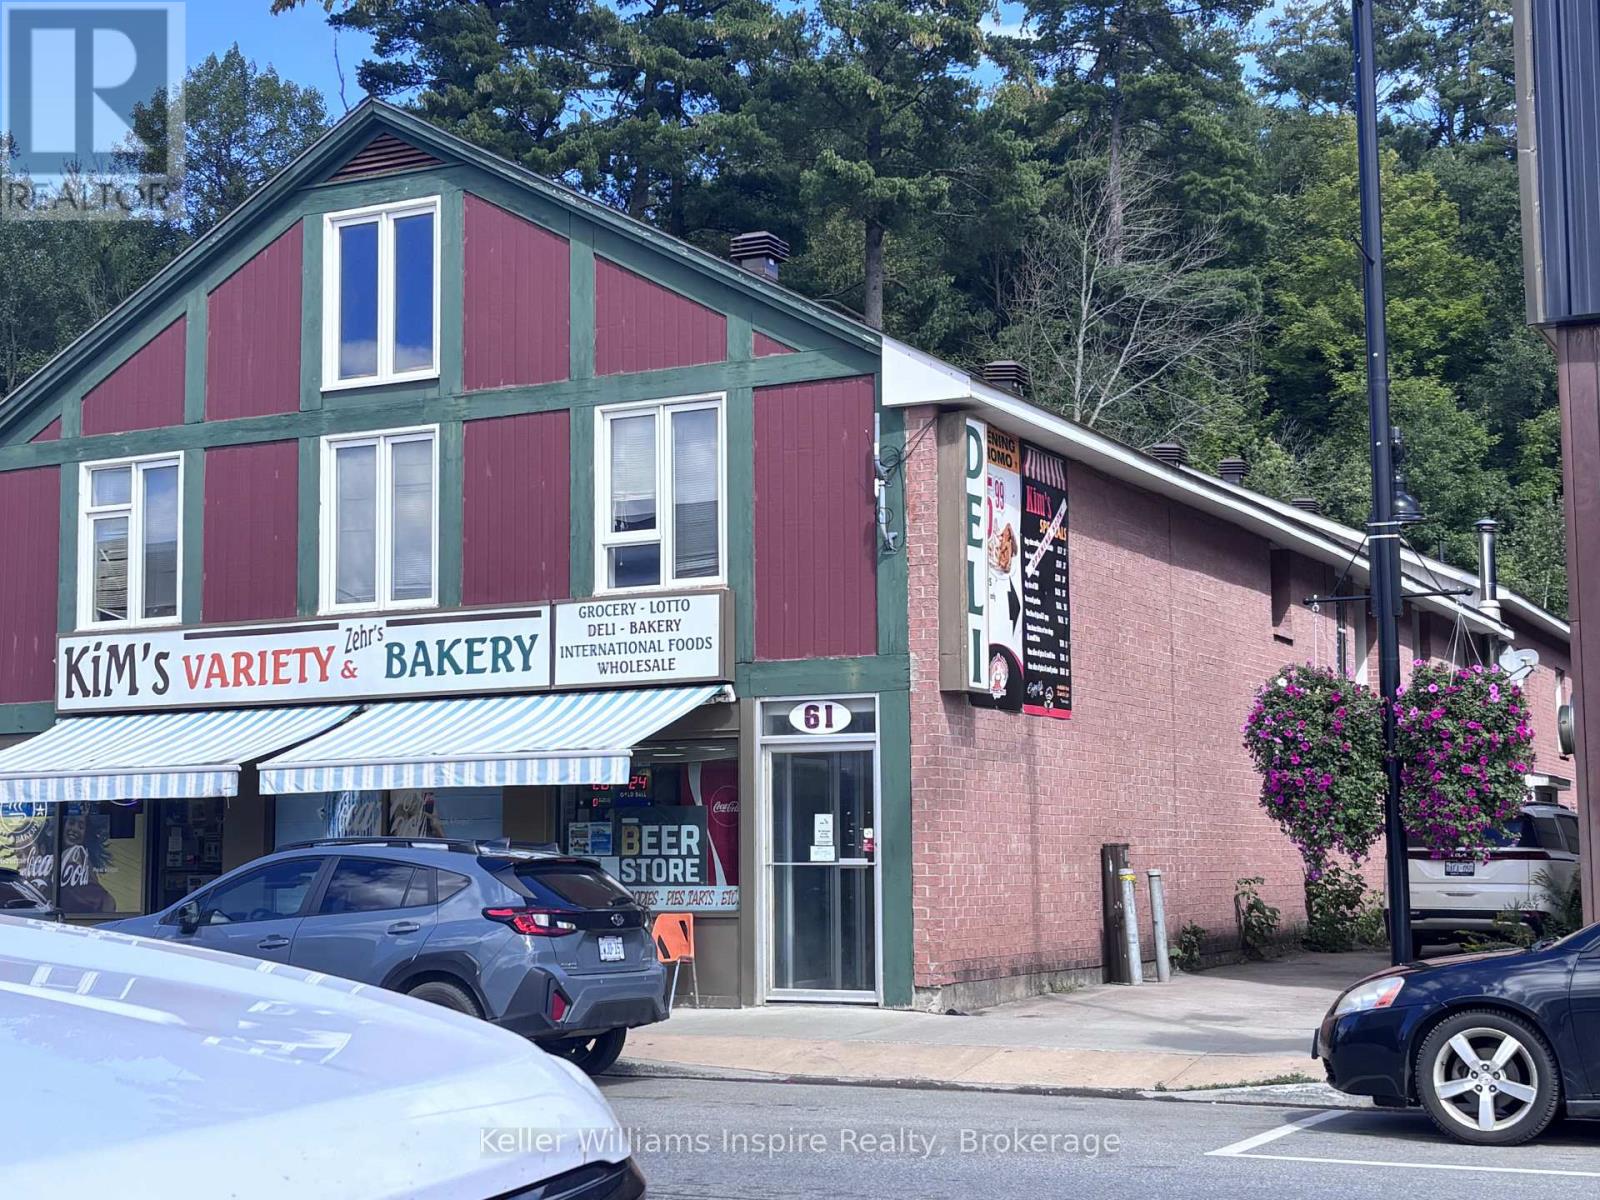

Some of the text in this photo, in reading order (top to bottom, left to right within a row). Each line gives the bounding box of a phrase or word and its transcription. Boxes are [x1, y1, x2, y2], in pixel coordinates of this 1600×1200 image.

[1026, 484, 1053, 519] Kim's
[966, 424, 984, 684] DELI
[578, 602, 636, 619] GROCERY
[649, 598, 691, 614] LOTTO
[344, 624, 384, 654] Zehr's
[588, 623, 616, 638] DELI
[629, 618, 682, 635] BAKERY
[384, 633, 539, 679] BAKERY
[560, 636, 713, 659] INTERNATIONAL FOODS
[182, 644, 336, 690] VARIETY
[340, 659, 358, 680] &
[597, 657, 676, 675] WHOLESALE
[804, 704, 834, 729] 61
[621, 824, 700, 856] BEER
[621, 858, 700, 883] STORE
